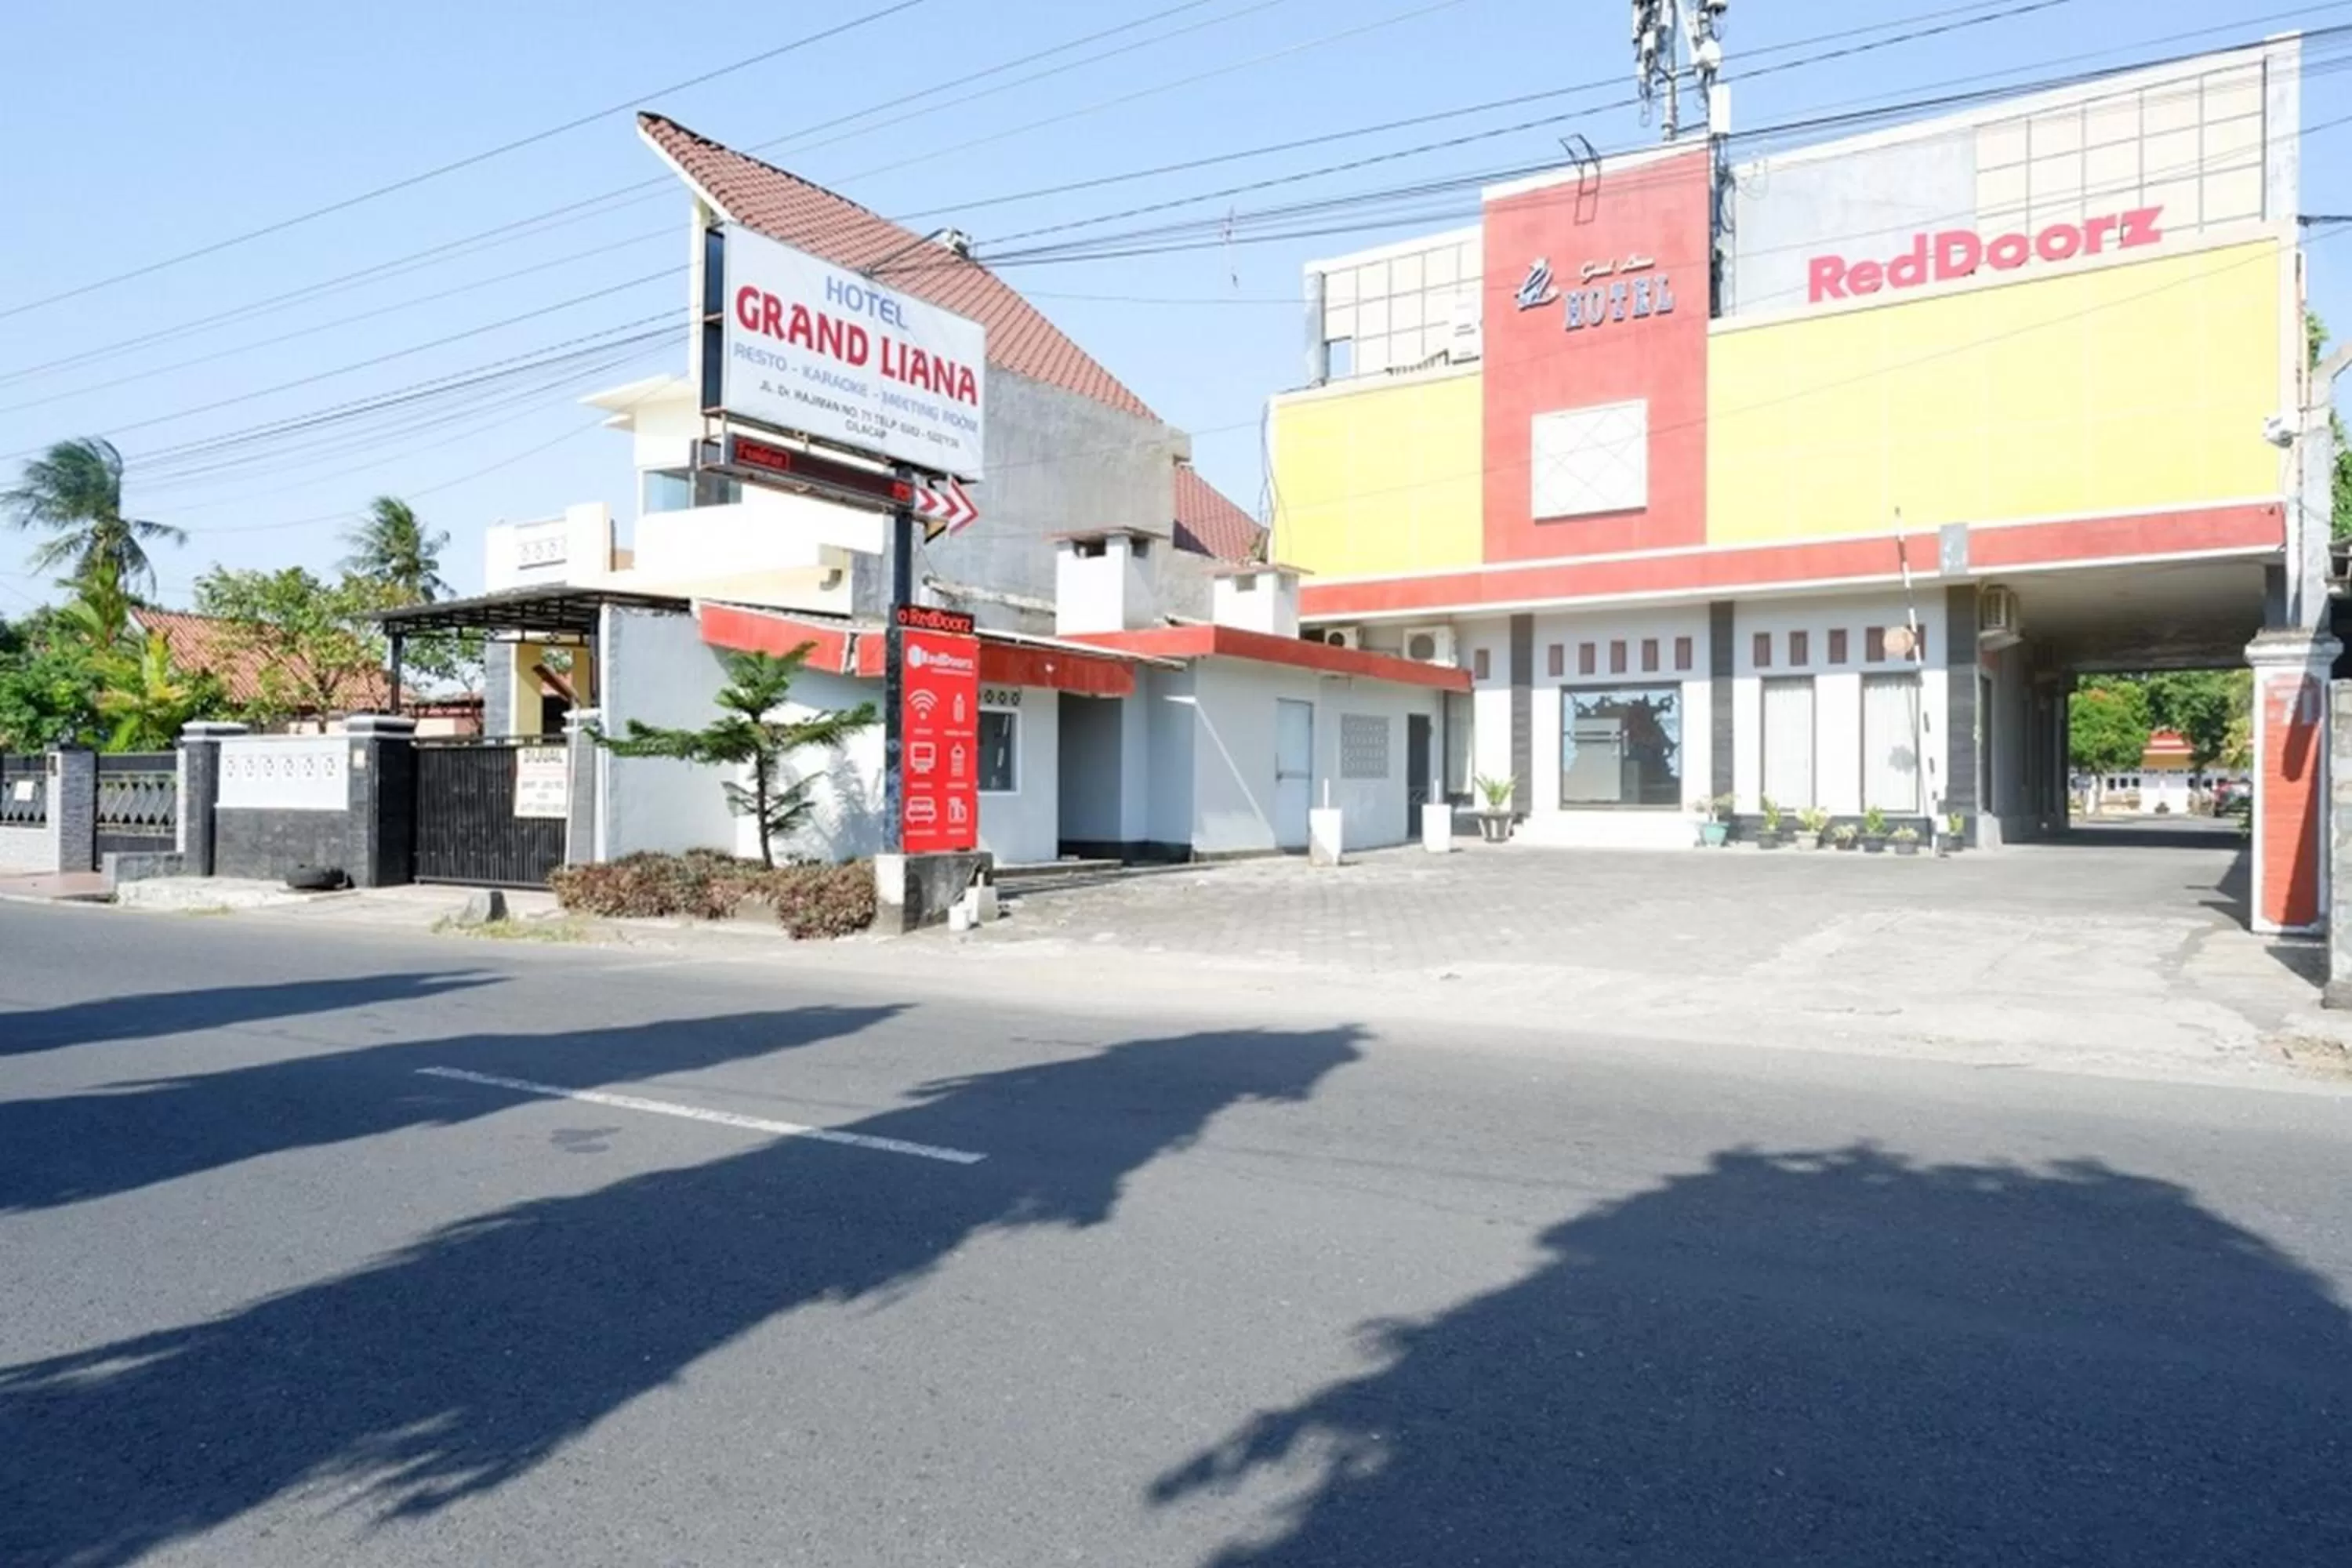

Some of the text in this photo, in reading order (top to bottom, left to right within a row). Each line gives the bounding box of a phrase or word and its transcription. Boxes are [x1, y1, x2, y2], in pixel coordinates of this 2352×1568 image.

[1808, 205, 2165, 304] RedDoorz
[735, 285, 978, 406] GRAND LIANA
[826, 275, 909, 330] HOTEL
[1565, 273, 1675, 332] HOTEL
[733, 342, 788, 372] RESTO
[802, 364, 868, 398] KARAOKE
[881, 391, 939, 422] MEETING
[942, 410, 978, 432] ROOM
